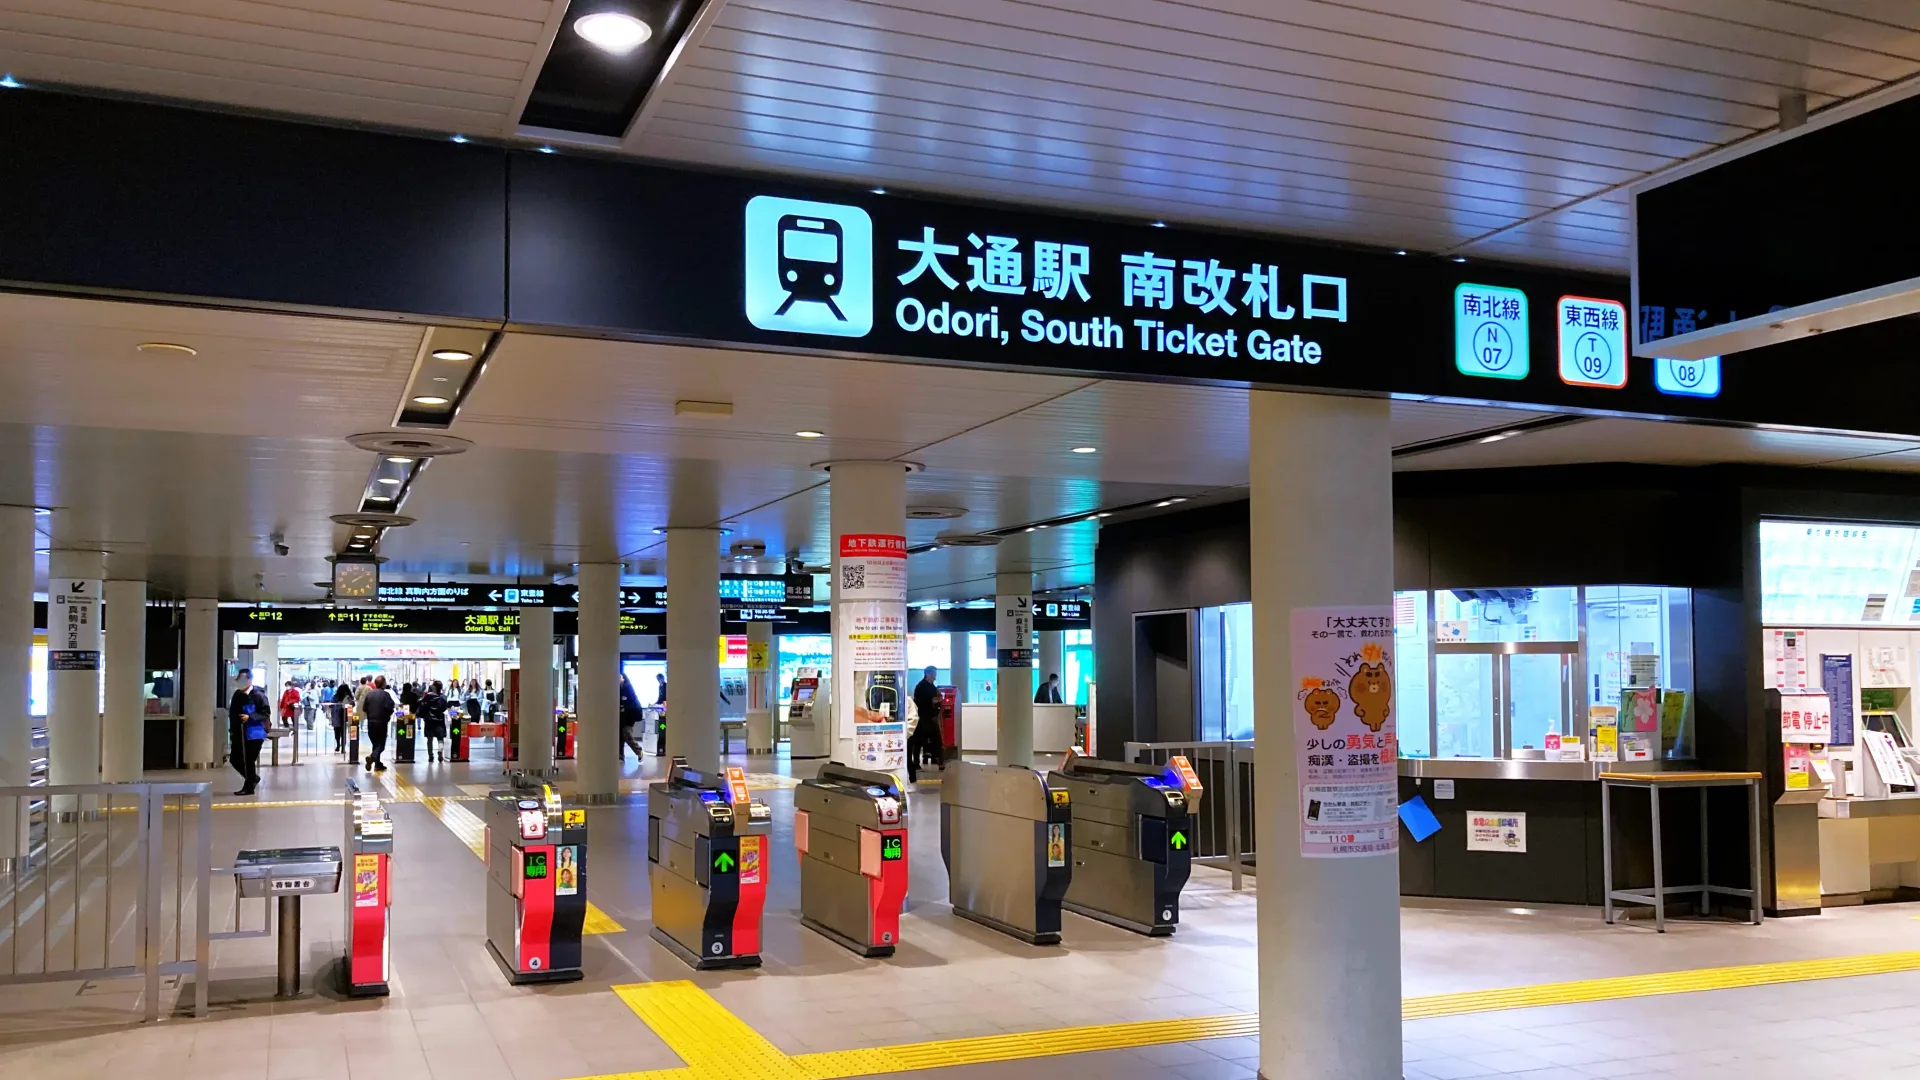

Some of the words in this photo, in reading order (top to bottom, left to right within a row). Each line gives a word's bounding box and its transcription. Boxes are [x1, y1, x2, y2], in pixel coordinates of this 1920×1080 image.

[897, 226, 1091, 302] 大通駅
[1121, 252, 1348, 323] 南改札口
[1463, 293, 1521, 321] 南北線
[1565, 305, 1619, 331] 東西線
[896, 298, 1009, 346] Odori,
[1021, 309, 1123, 349] South
[1133, 319, 1238, 358] Ticket
[1247, 329, 1322, 365] Gate
[1487, 328, 1497, 343] N
[1588, 338, 1597, 352] T
[1483, 347, 1502, 364] 07
[1584, 356, 1602, 373] 09
[1678, 365, 1696, 382] 08
[378, 587, 403, 596] 南北線
[271, 612, 282, 620] 12
[349, 613, 360, 621] 11
[465, 615, 499, 625] 大通駅
[68, 606, 78, 648] 真駒内方面
[886, 838, 900, 848] IC
[1333, 844, 1373, 853] 札幌市交通局
[529, 855, 546, 866] IC
[271, 881, 310, 889] 荷物置台
[884, 933, 890, 941] 2
[714, 944, 720, 952] 3
[531, 959, 538, 967] 4
